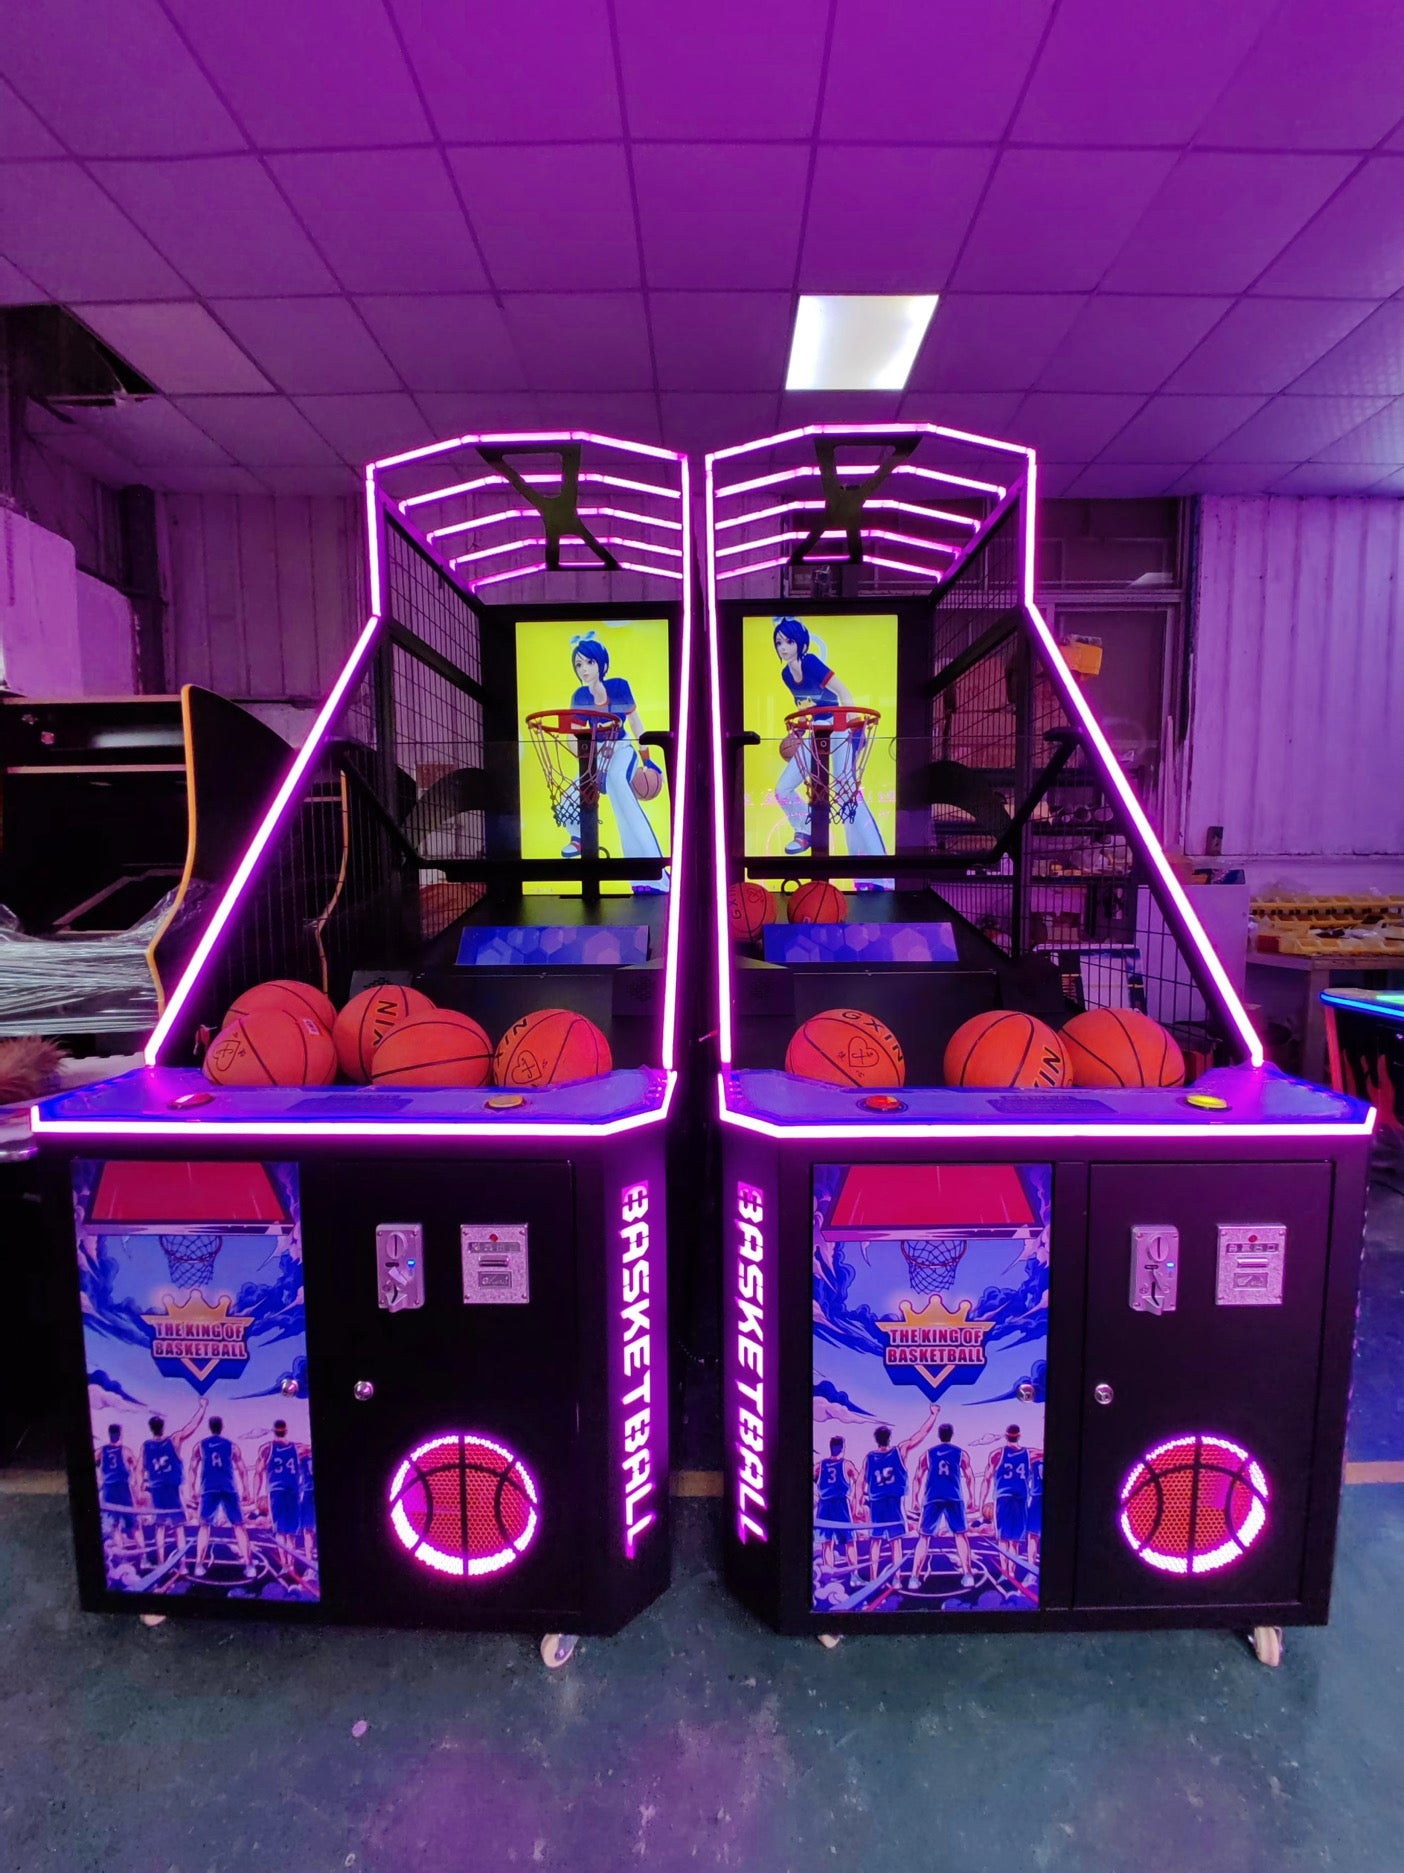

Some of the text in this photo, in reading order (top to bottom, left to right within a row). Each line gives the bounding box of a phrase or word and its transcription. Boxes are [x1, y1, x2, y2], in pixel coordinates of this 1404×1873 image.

[842, 1010, 903, 1062] GXIN
[1033, 1046, 1061, 1088] IN
[156, 1323, 243, 1340] THE KING OF
[889, 1328, 982, 1345] THE KING OF
[154, 1341, 246, 1358] BASKETBALL
[887, 1347, 983, 1364] BASKETBALL
[620, 1180, 657, 1559] BASKETBALL
[735, 1181, 768, 1545] BASKETBALL
[109, 1454, 119, 1469] 3
[827, 1467, 837, 1484] 3
